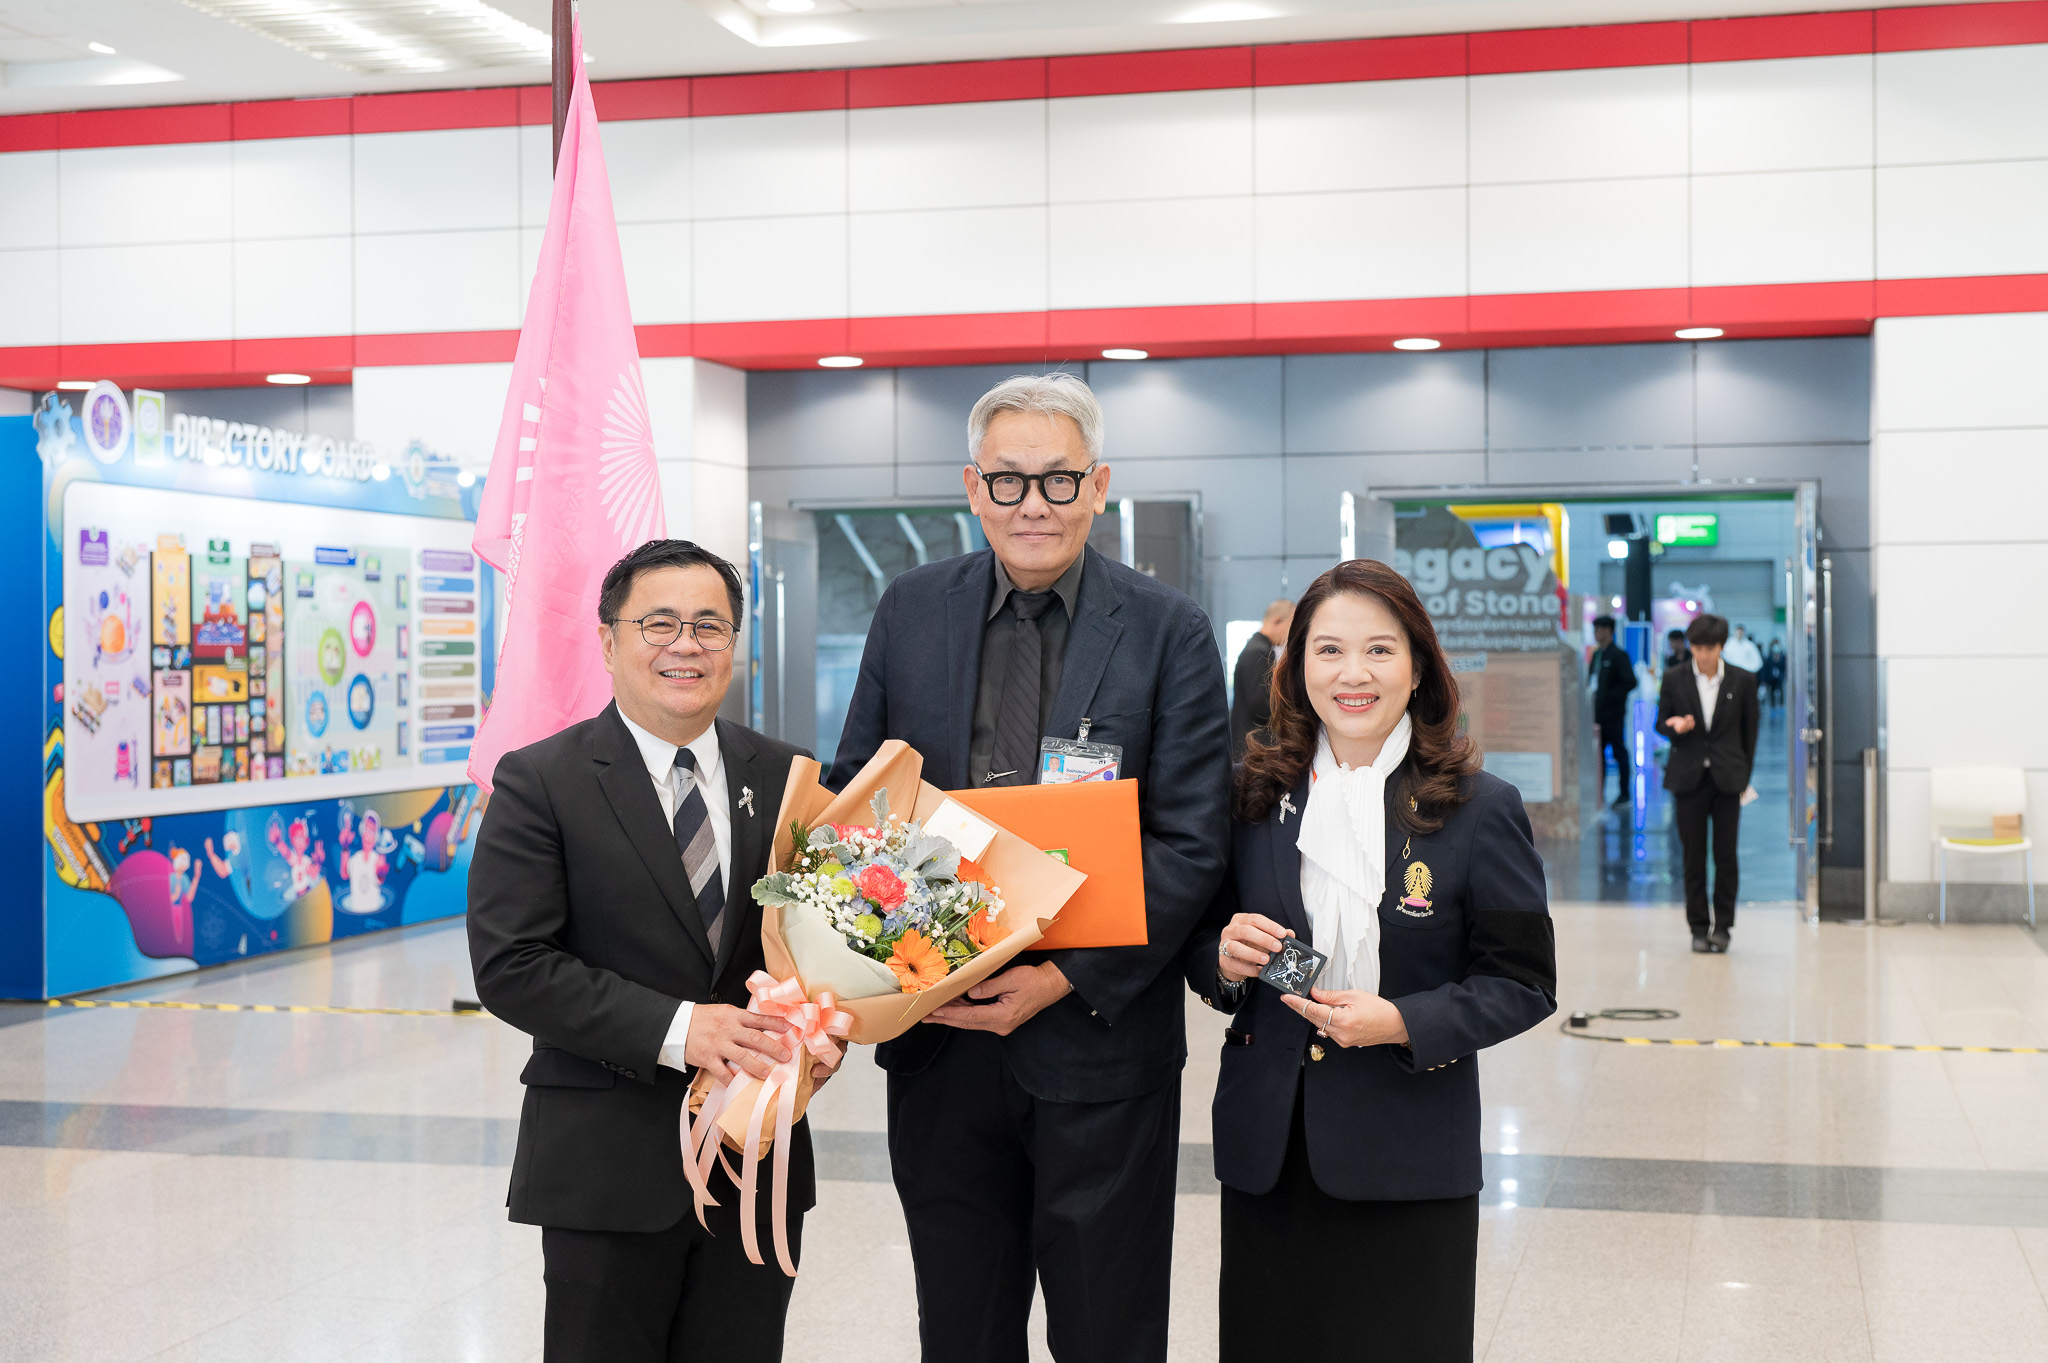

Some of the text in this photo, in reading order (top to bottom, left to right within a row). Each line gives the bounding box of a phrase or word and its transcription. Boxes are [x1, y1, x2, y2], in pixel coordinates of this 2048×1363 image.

[1395, 546, 1552, 594] gacy
[1425, 587, 1561, 616] of Stone
[53, 826, 87, 881] TECHNOLOGY
